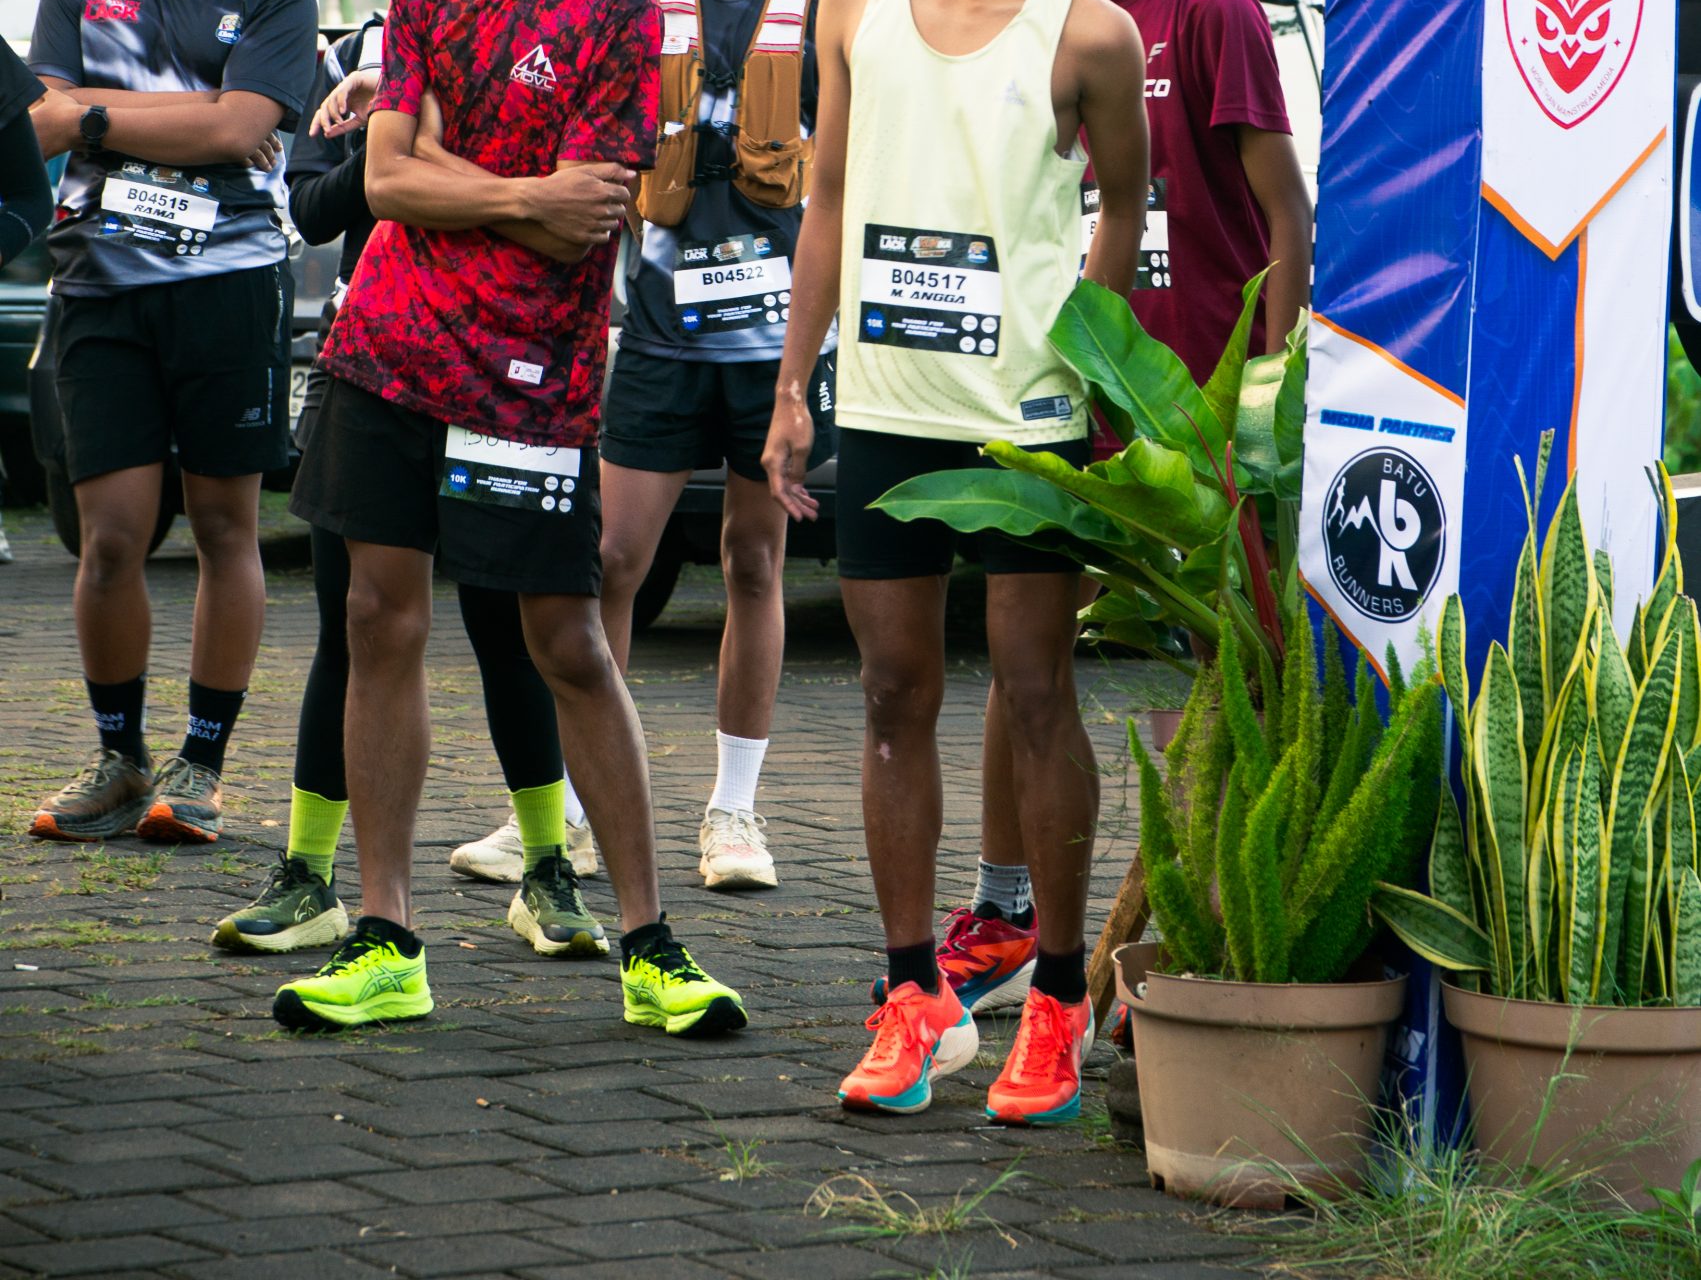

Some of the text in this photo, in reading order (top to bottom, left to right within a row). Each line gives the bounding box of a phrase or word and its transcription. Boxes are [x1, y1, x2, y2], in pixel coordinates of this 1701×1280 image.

[85, 5, 139, 21] LACK
[127, 188, 189, 212] B04515
[134, 204, 175, 220] RAMA
[702, 266, 764, 285] B04522
[892, 269, 967, 290] B04517
[910, 291, 966, 304] ANGGA
[819, 381, 832, 412] RUN
[1320, 409, 1456, 443] MEDIA PARTNER
[450, 474, 466, 484] 10K
[1383, 458, 1427, 497] BATU
[1333, 555, 1404, 614] RUNNERS
